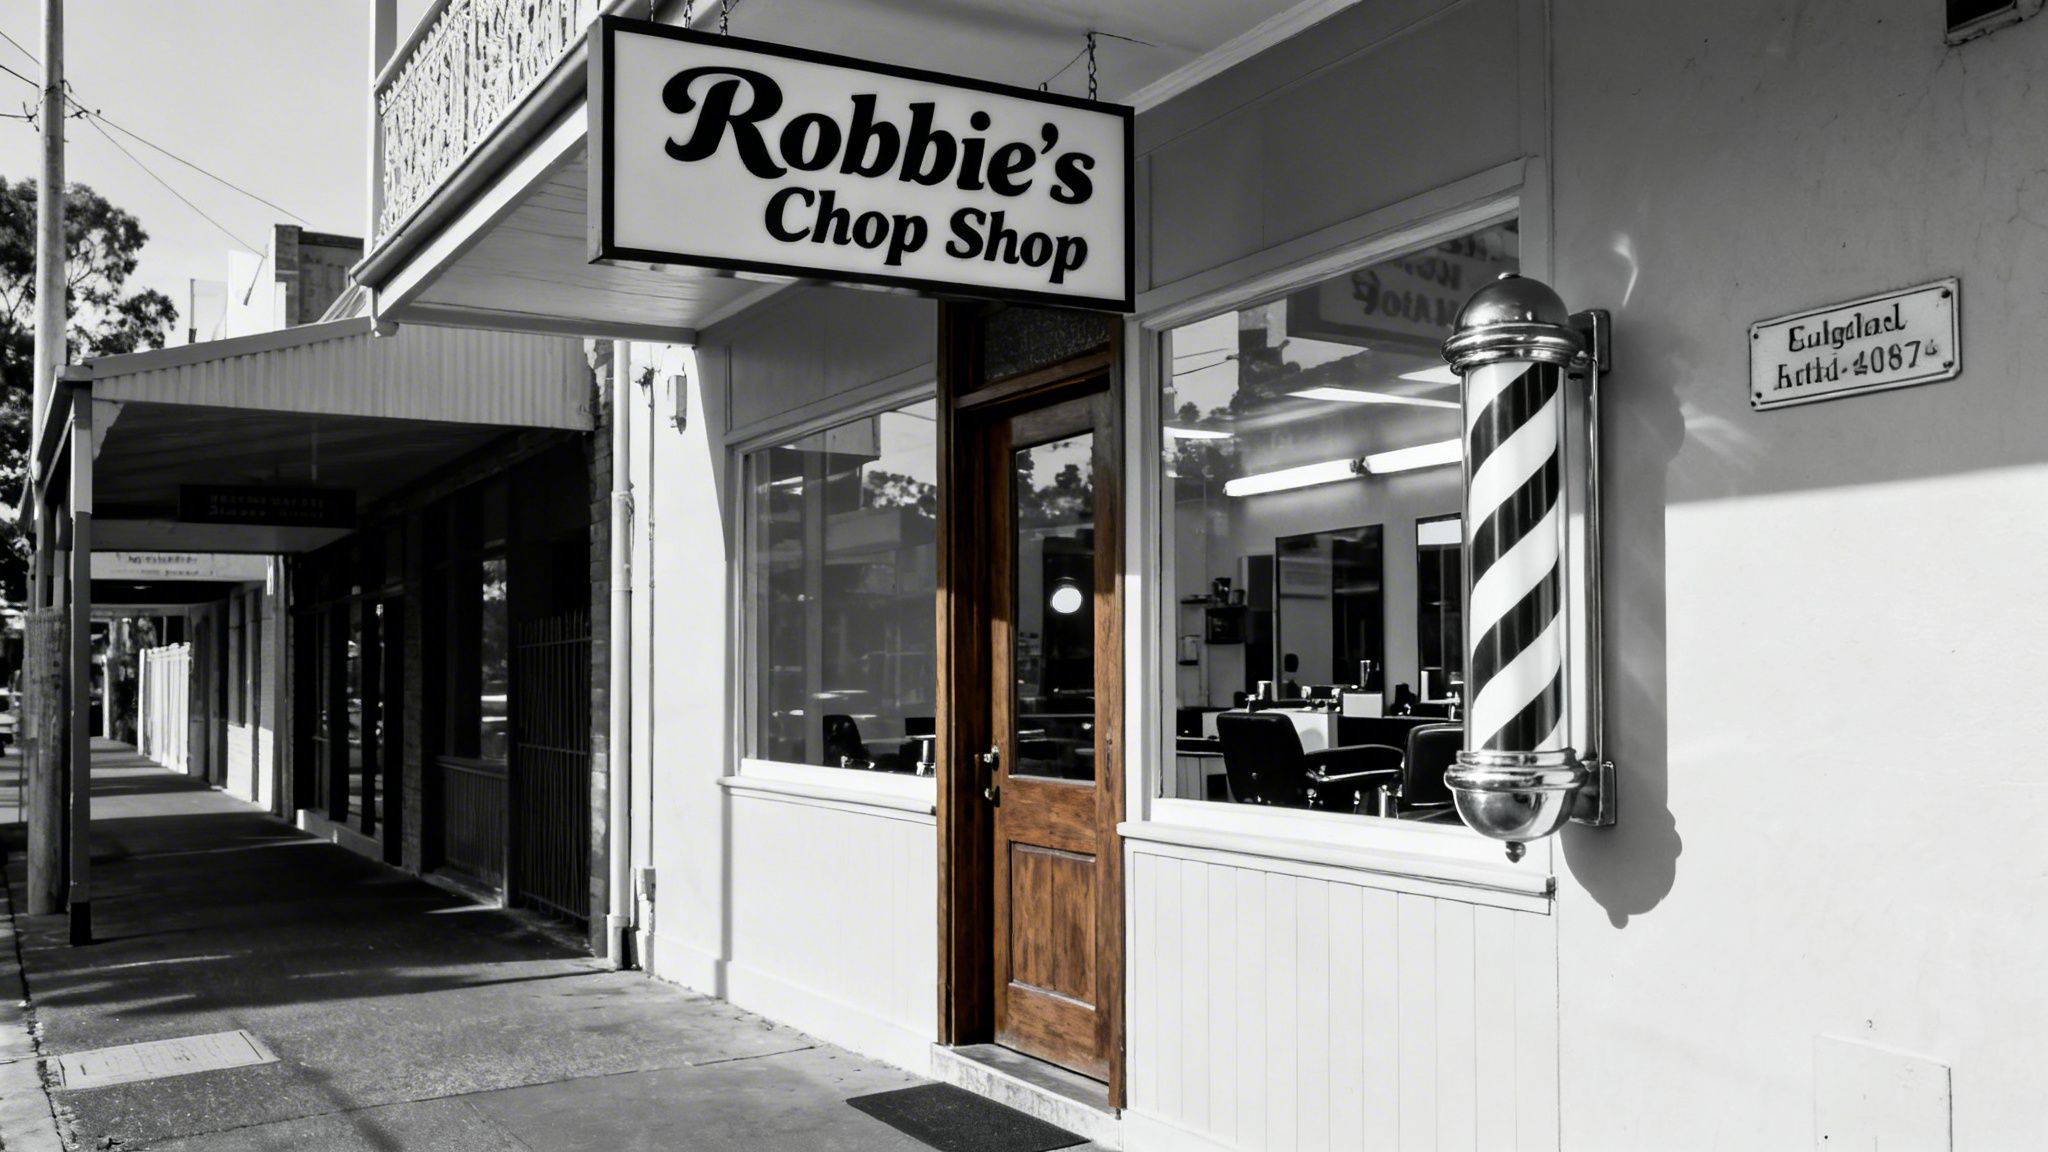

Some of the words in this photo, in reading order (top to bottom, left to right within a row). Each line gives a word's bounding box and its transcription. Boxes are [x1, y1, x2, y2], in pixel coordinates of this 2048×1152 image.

[661, 65, 1096, 205] Robbie’s
[764, 186, 928, 267] Chop
[945, 207, 1089, 285] Shop
